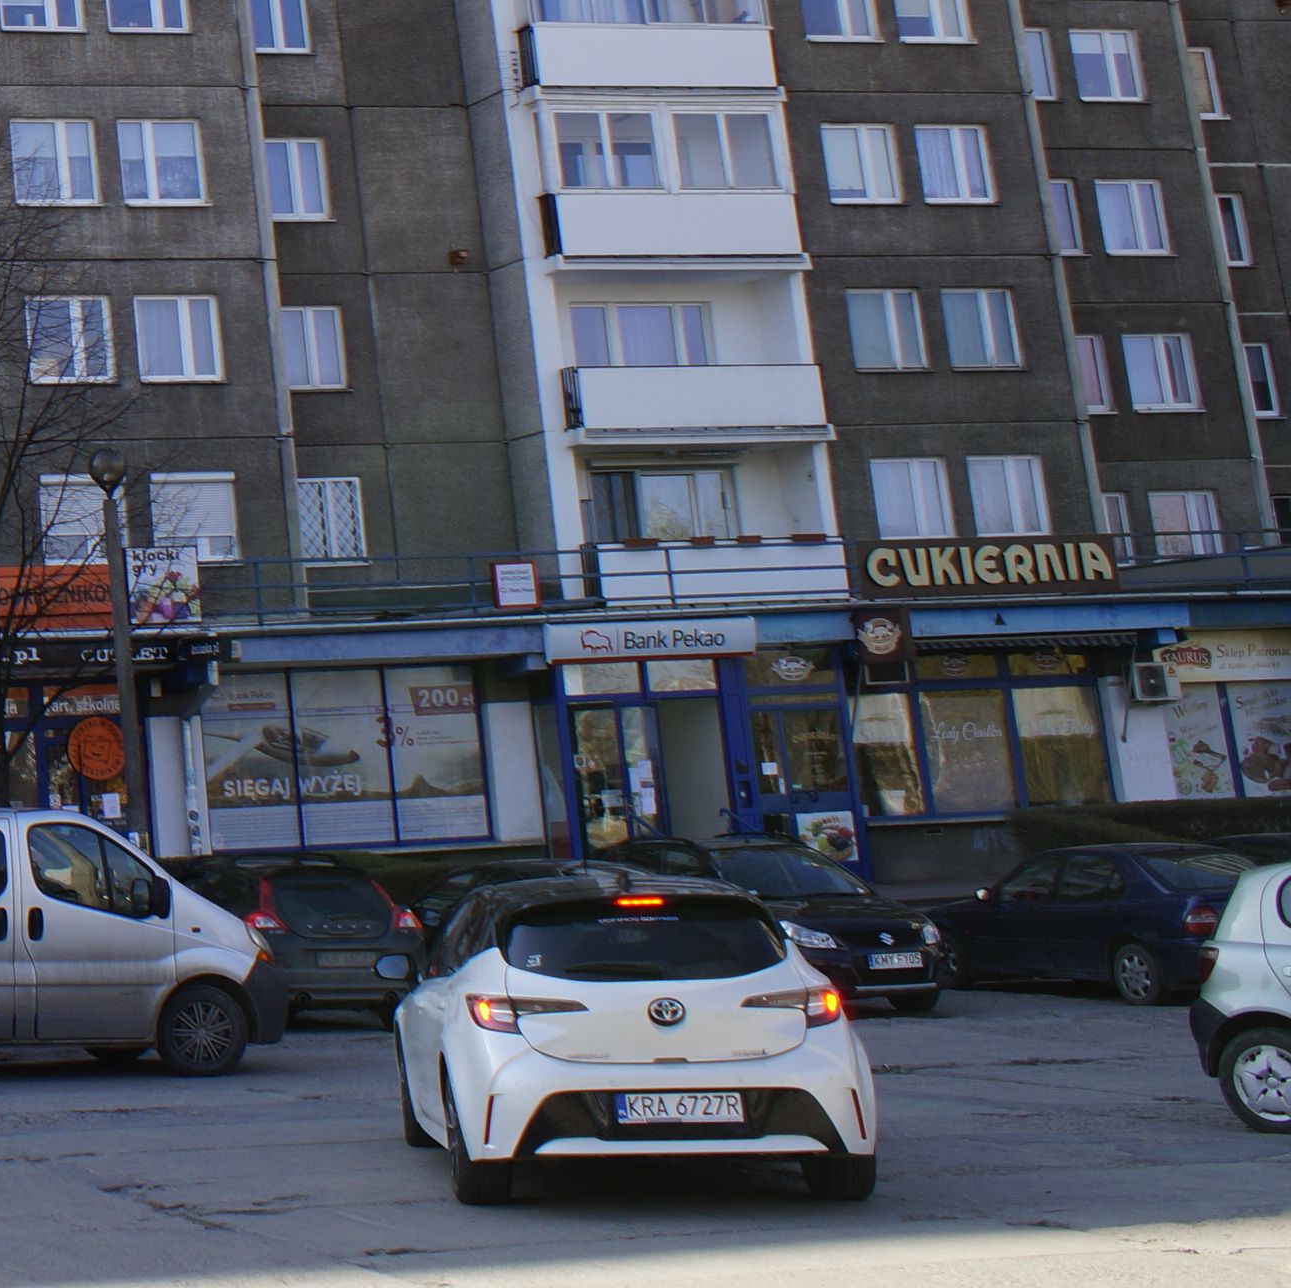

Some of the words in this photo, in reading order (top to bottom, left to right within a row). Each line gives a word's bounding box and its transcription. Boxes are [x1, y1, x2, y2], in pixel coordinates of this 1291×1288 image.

[132, 548, 179, 562] klocki
[866, 542, 1113, 587] CUKIERNIA
[132, 563, 157, 577] gry
[624, 631, 668, 649] Bank
[672, 628, 725, 648] Pekao
[80, 646, 168, 662] OULET
[1163, 650, 1209, 664] TAURUS
[1216, 643, 1245, 659] Sklep
[419, 688, 459, 707] 200
[931, 722, 960, 743] Lody
[223, 777, 290, 801] SIĘGAJ
[298, 770, 361, 795] WYŻEJ
[874, 954, 894, 966] KMY
[627, 1095, 669, 1117] KRA
[675, 1095, 740, 1116] 6727R
